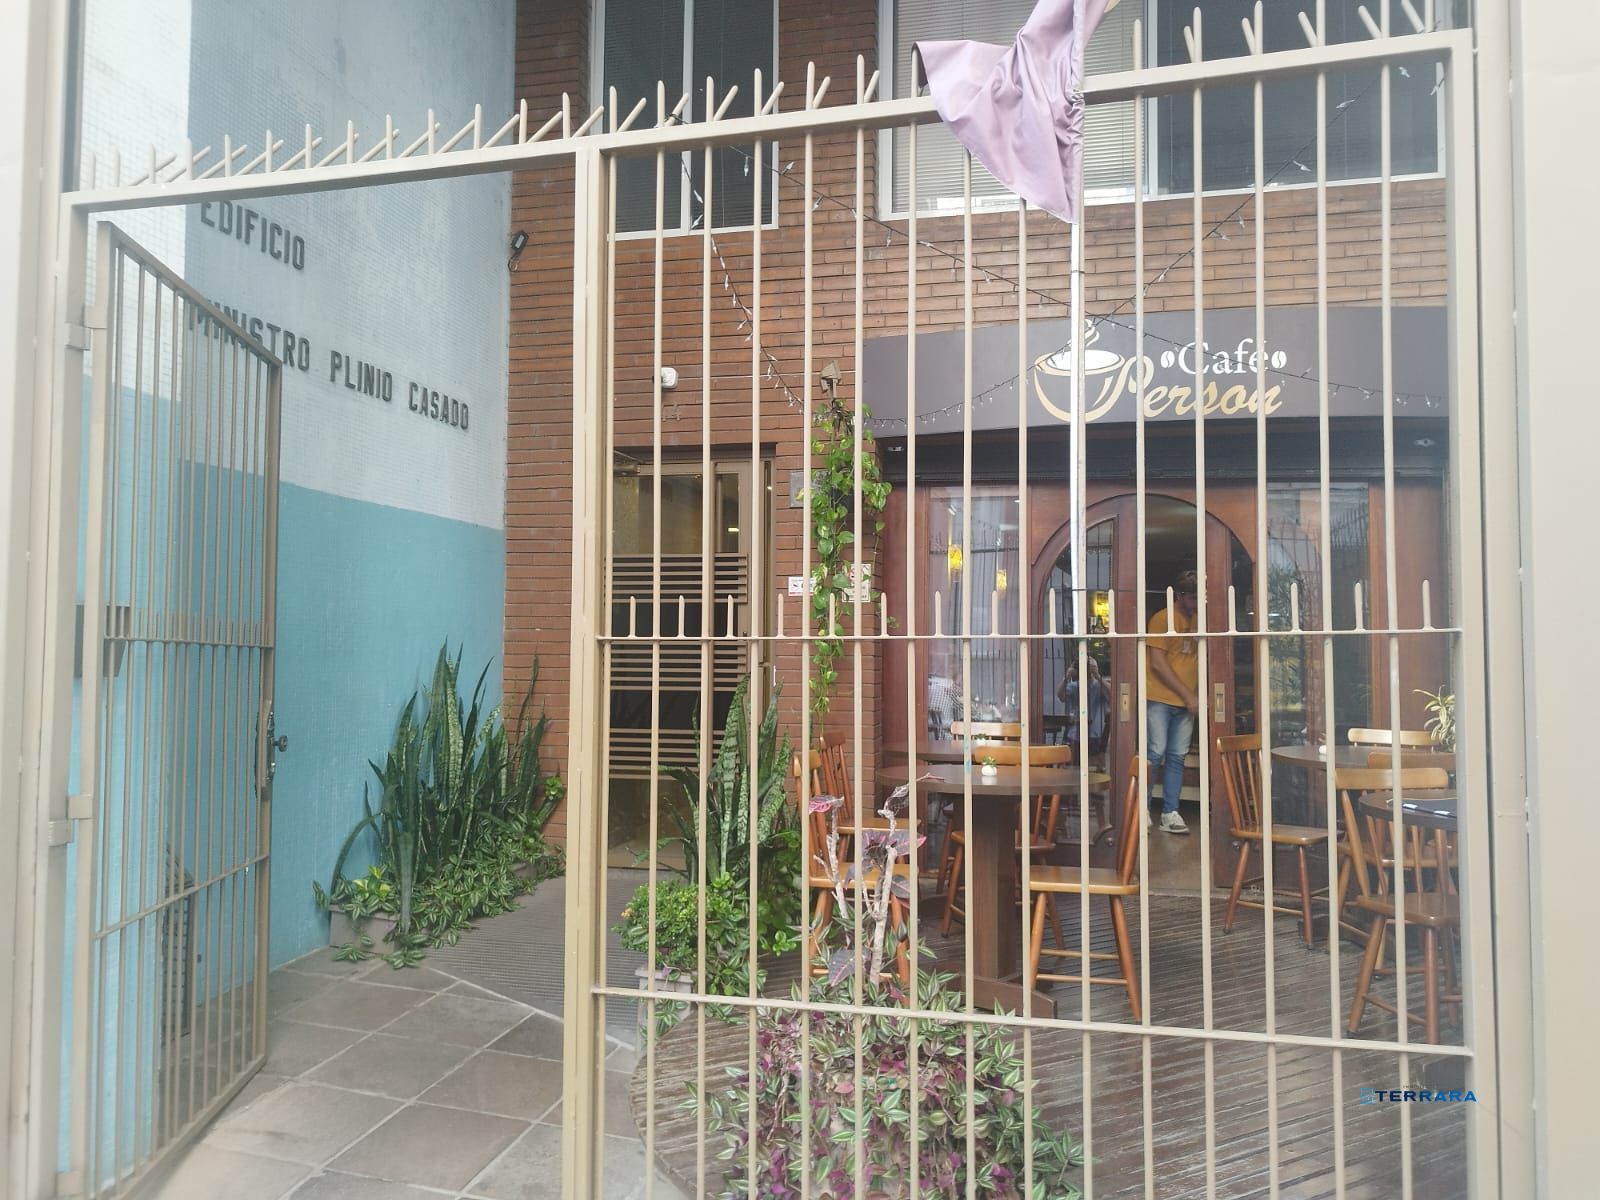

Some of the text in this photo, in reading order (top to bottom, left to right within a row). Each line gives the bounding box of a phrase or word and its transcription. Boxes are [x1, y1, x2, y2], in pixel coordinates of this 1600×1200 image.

[201, 199, 305, 270] EDIFICIO
[330, 350, 393, 402] PLINIO
[409, 382, 469, 430] CASADO
[1178, 338, 1269, 375] Café
